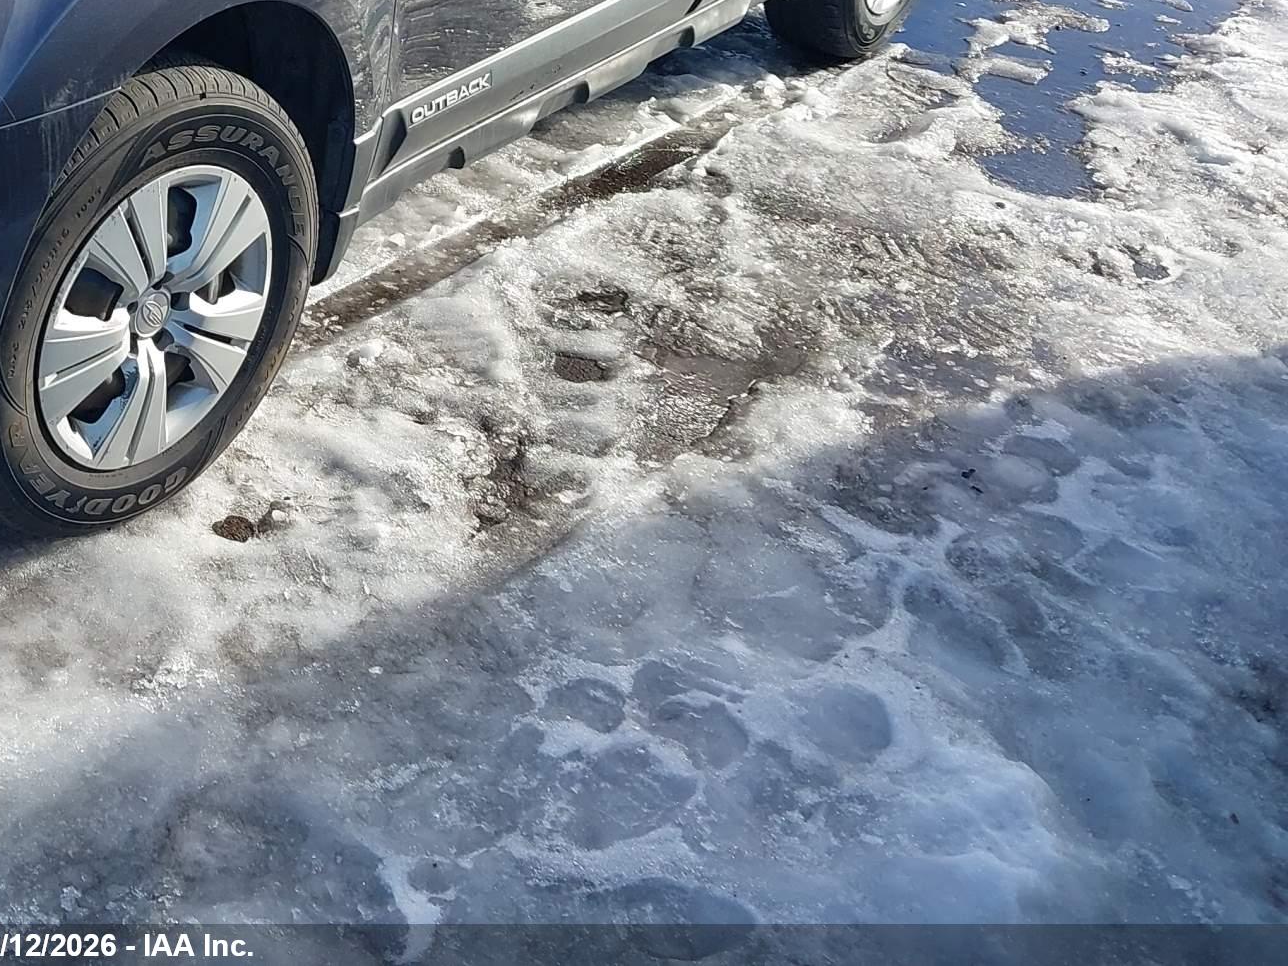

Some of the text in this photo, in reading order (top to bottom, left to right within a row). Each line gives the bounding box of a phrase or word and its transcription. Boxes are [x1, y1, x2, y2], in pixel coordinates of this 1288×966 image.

[411, 73, 491, 123] OUTBACK
[138, 125, 305, 236] ASSURANCE
[9, 422, 188, 515] GOODYEAR
